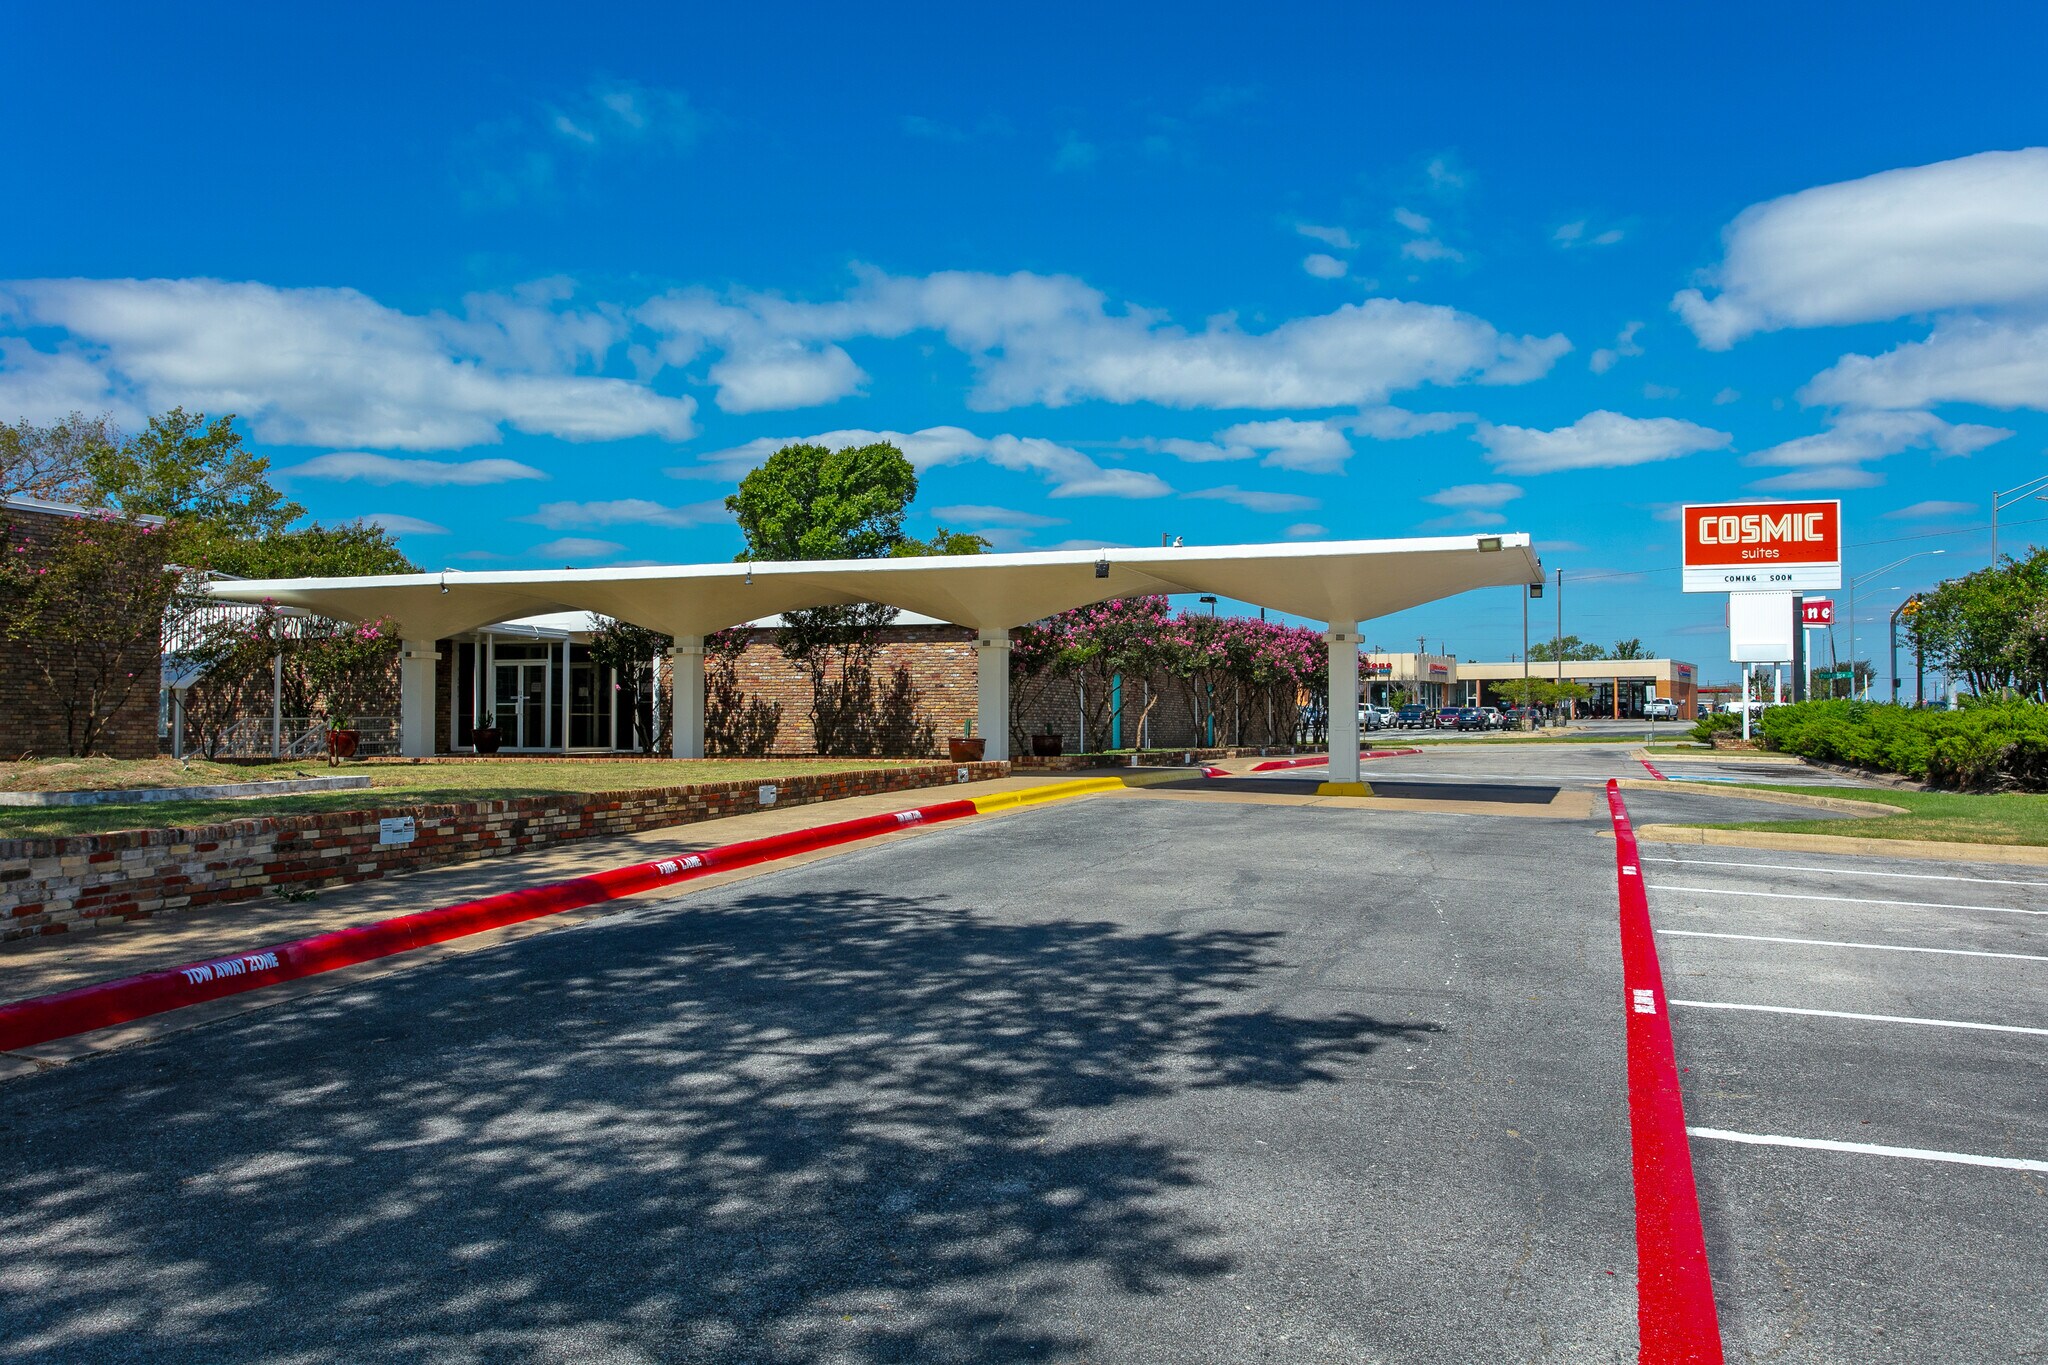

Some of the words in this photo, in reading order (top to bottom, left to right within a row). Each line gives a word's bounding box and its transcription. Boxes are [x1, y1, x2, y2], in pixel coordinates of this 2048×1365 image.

[1699, 512, 1823, 544] COSMIC
[1741, 547, 1780, 559] suites
[1724, 575, 1757, 583] COMING
[655, 861, 678, 874] FIRE
[677, 856, 702, 869] LANE
[181, 966, 213, 984] TOW
[212, 959, 246, 978] AWAY
[244, 952, 279, 971] ZONE
